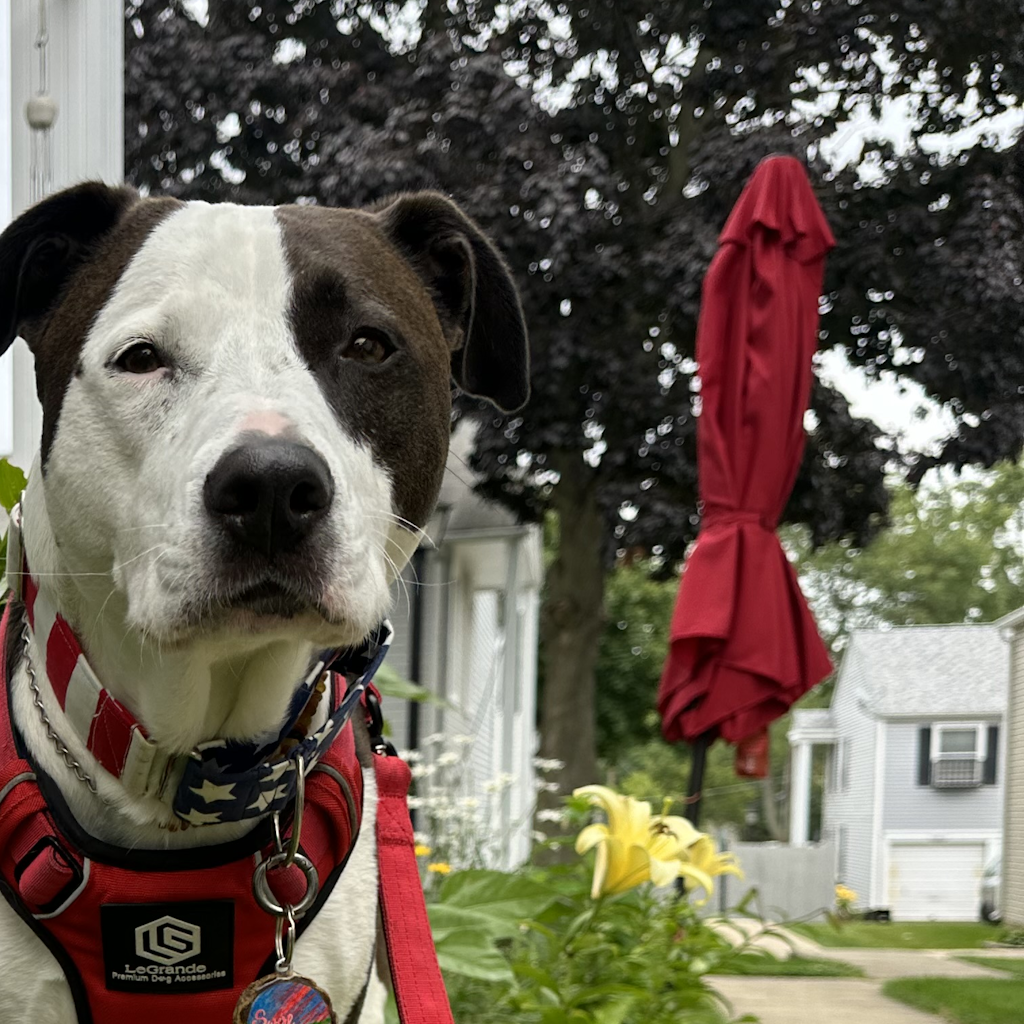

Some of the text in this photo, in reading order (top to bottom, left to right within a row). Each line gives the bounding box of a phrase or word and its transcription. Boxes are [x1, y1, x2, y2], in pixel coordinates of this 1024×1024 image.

[125, 963, 207, 975] LeGrande
[112, 971, 149, 982] Premium
[174, 969, 226, 982] Accessories
